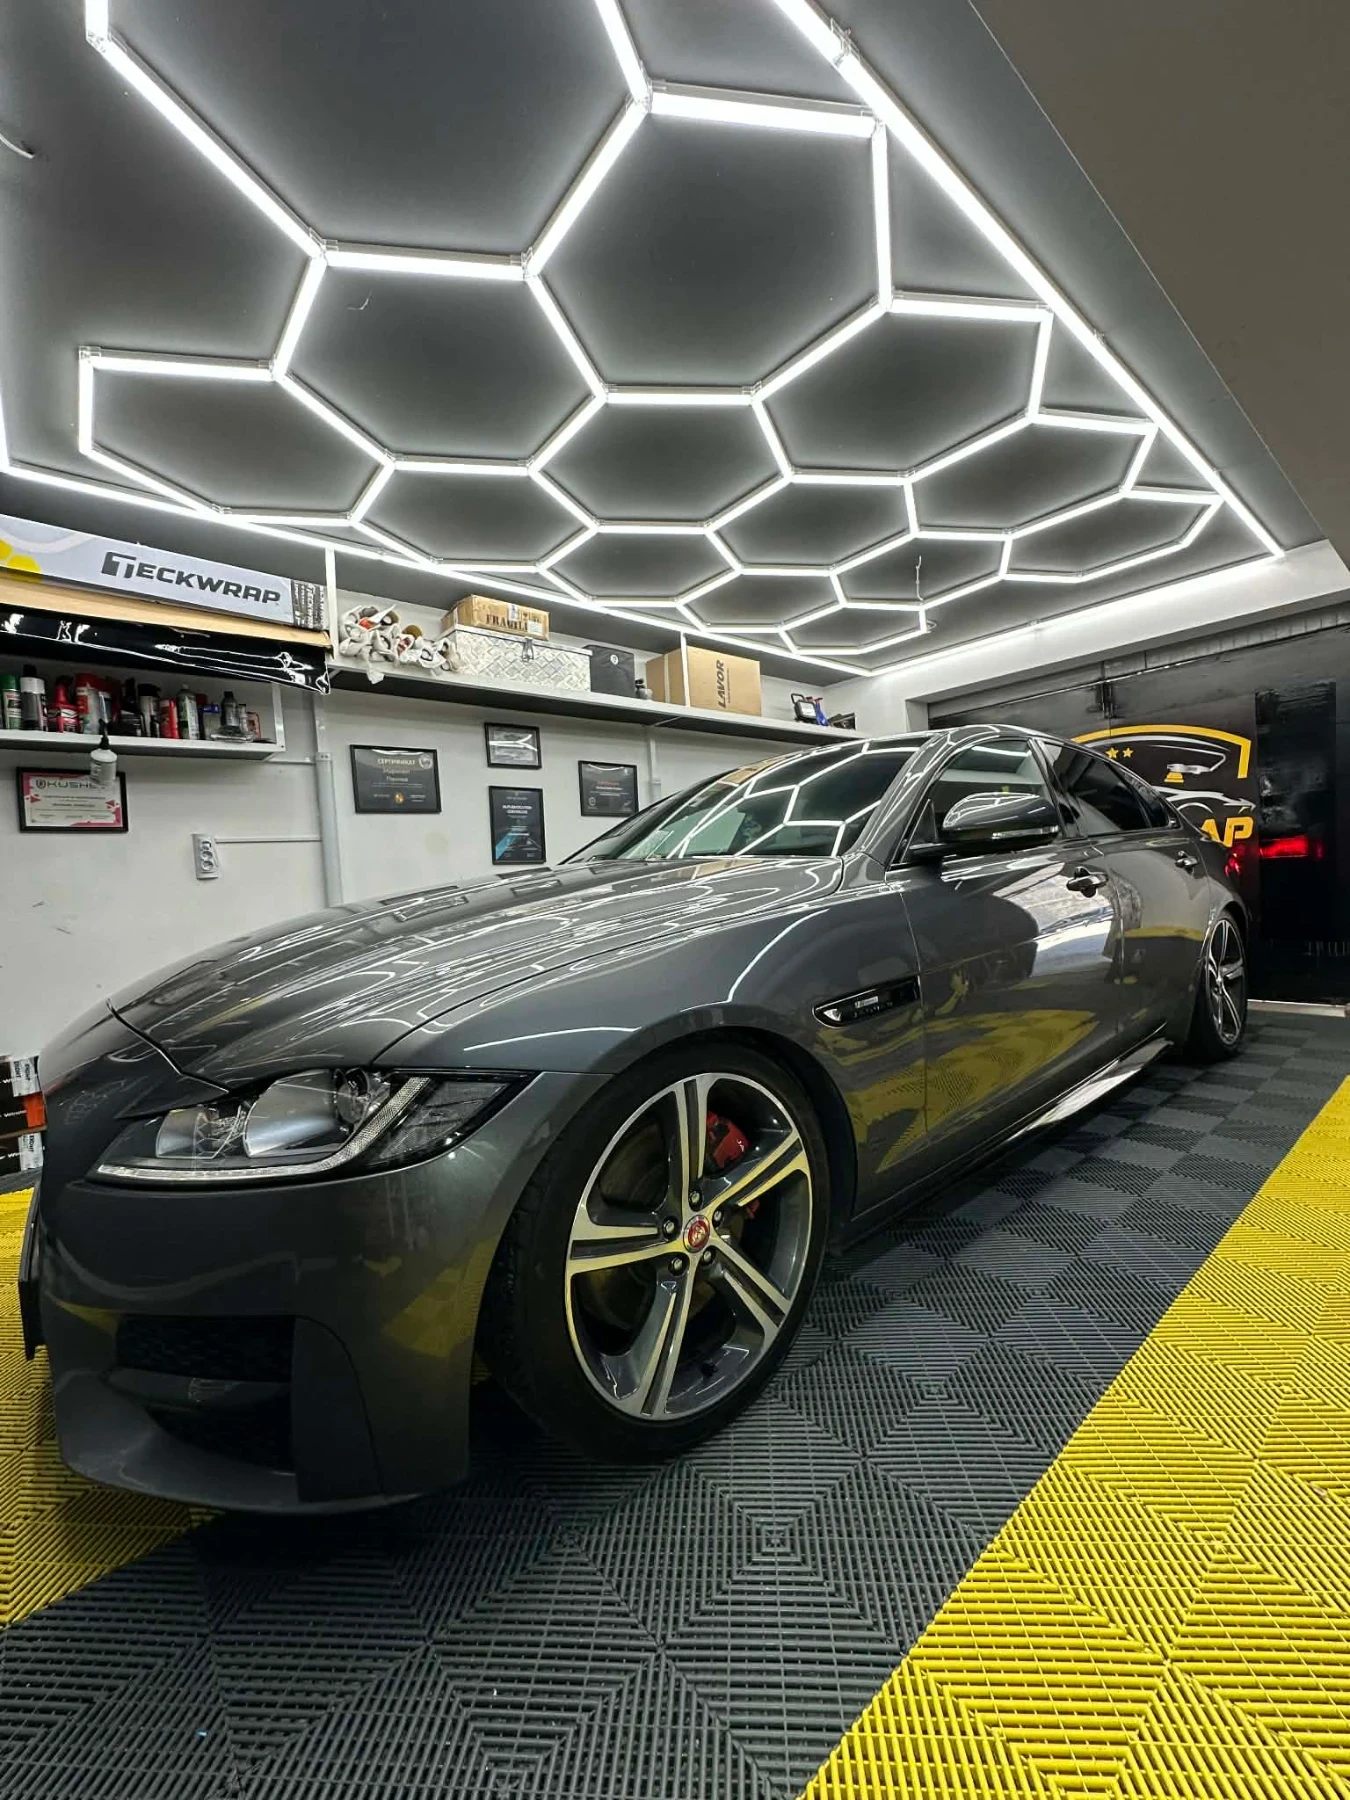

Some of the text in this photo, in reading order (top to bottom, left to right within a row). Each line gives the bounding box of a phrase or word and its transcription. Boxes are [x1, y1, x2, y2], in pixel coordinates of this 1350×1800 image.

[101, 551, 281, 604] TECKWRAP
[716, 659, 726, 709] LAVOR
[47, 781, 106, 790] KUSH
